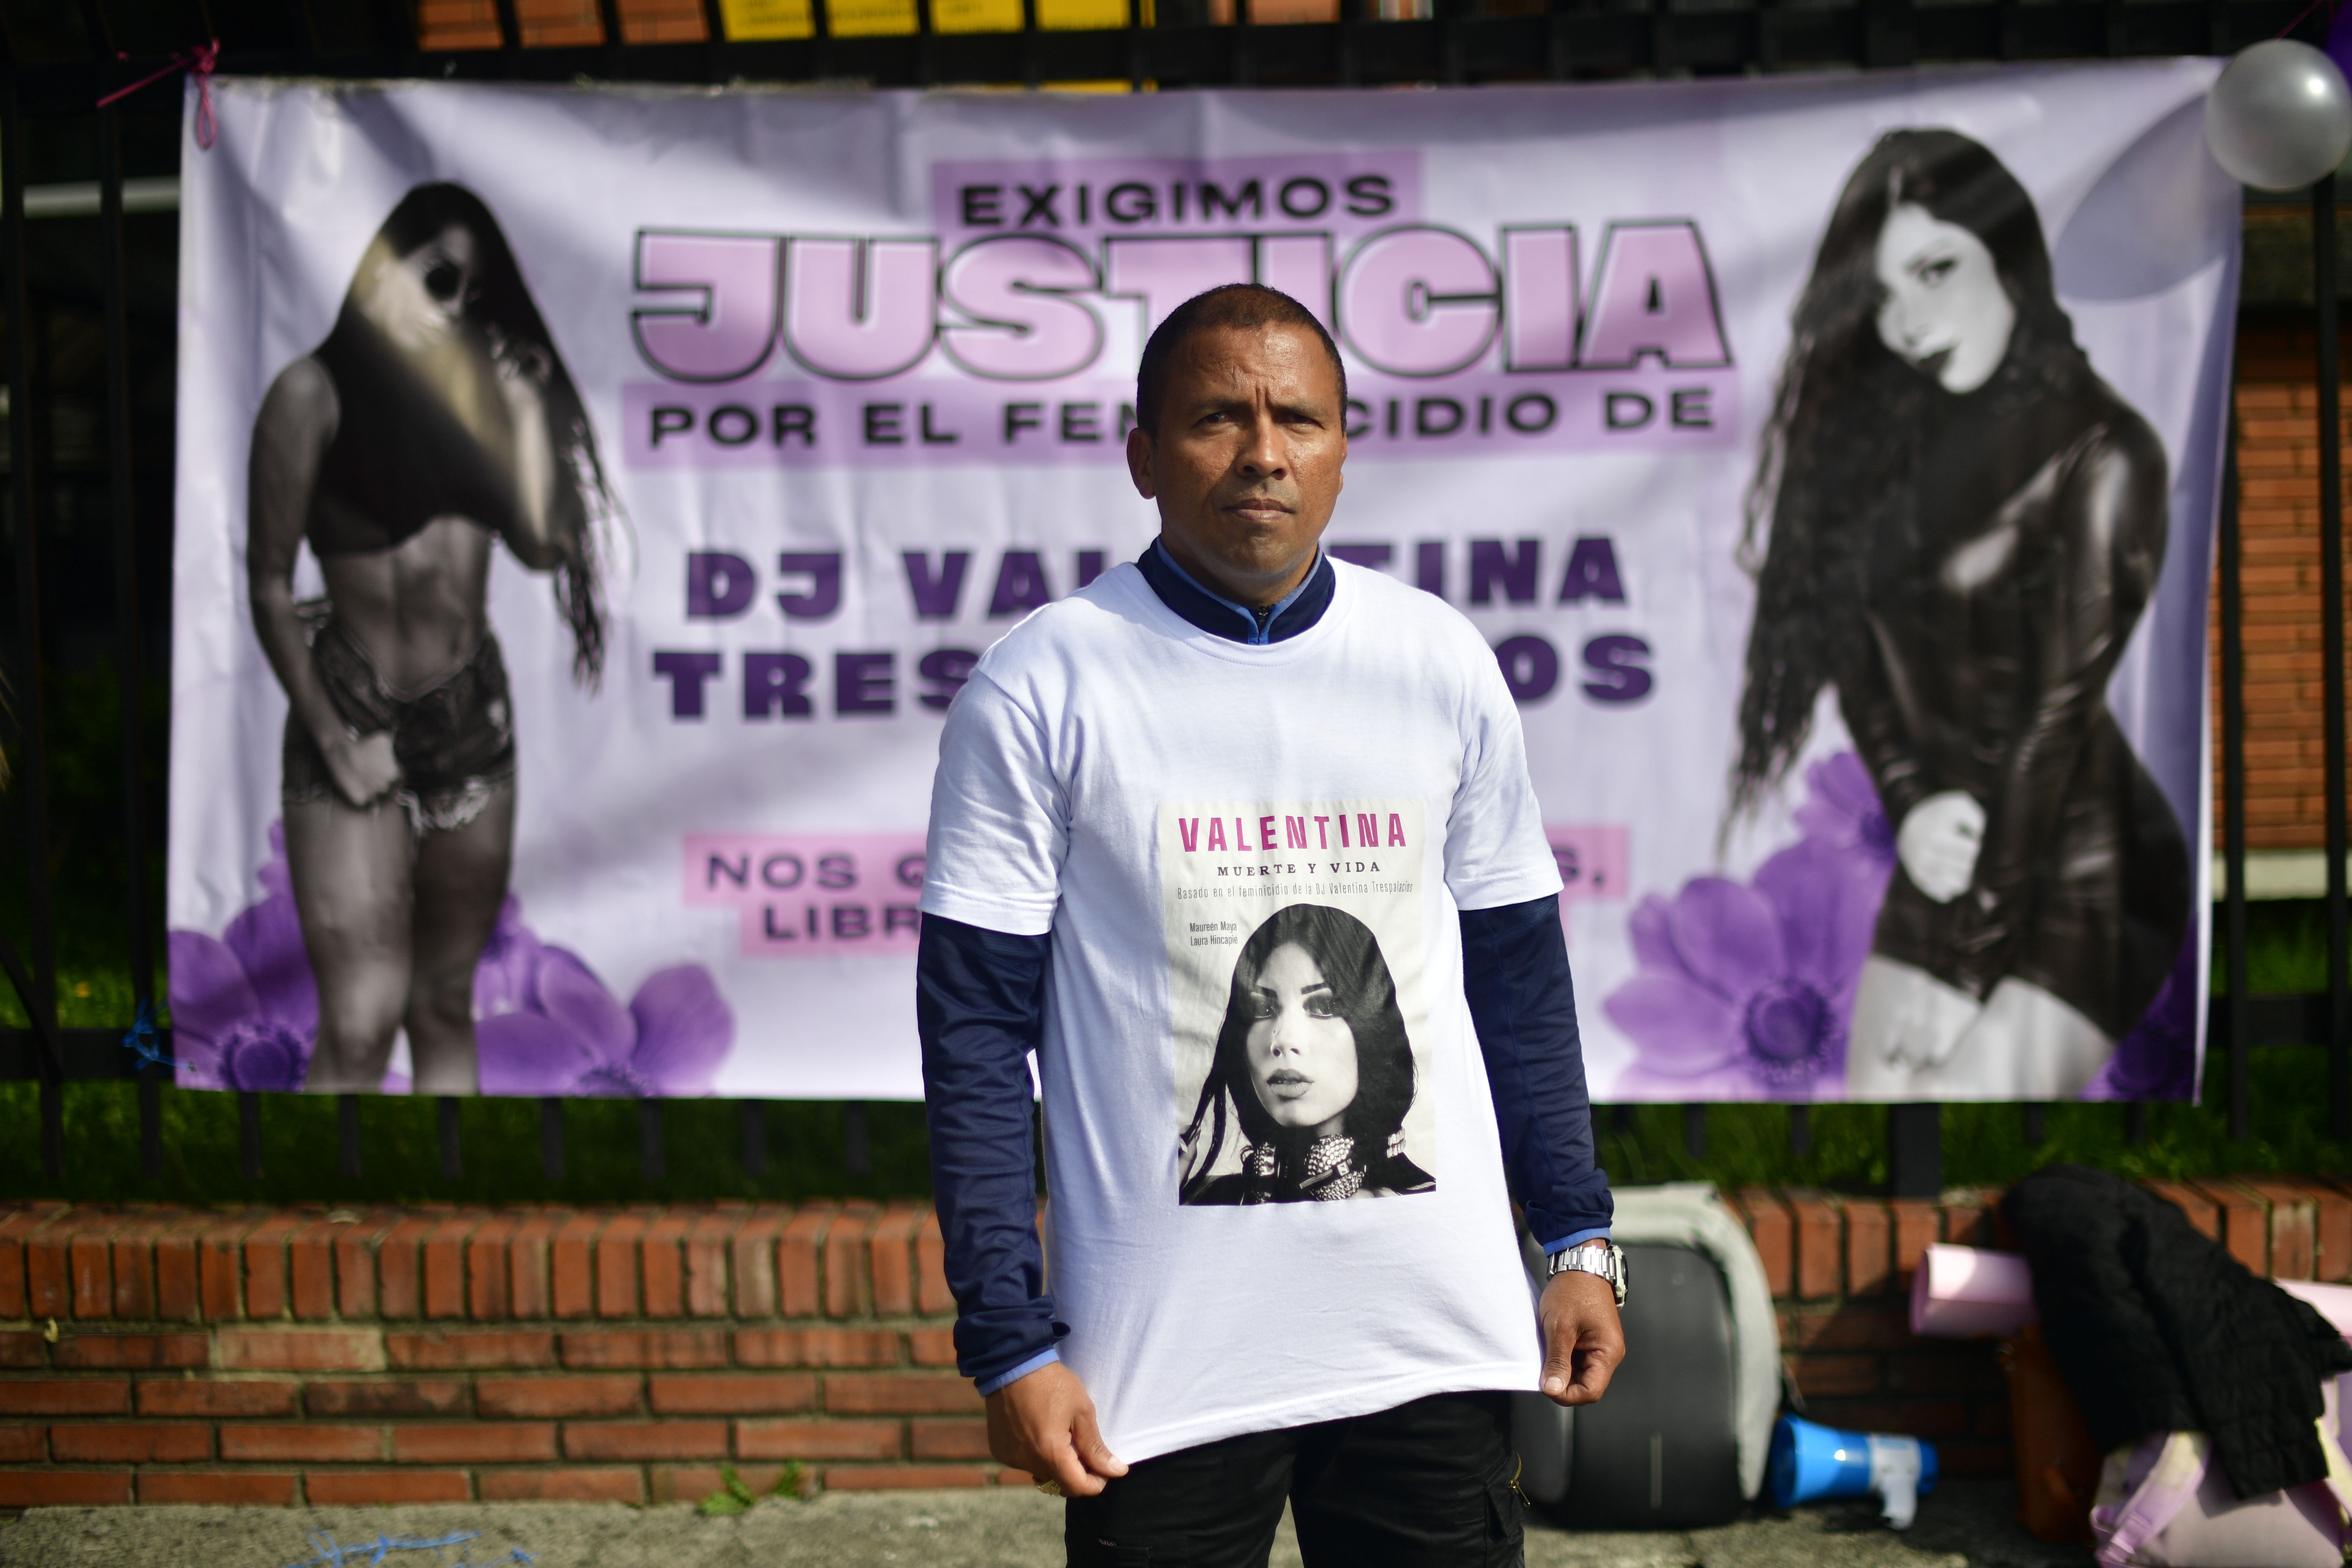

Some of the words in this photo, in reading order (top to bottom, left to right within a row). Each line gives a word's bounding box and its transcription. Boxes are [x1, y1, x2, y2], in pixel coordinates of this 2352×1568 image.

[962, 174, 1395, 226] EXIGIMOS
[629, 218, 1734, 384] JUSTICIA
[650, 404, 817, 447] POR
[863, 402, 958, 444] EL
[1605, 388, 1715, 430] DE
[686, 549, 844, 622] DJ
[1178, 813, 1406, 852] VALENTINA
[707, 854, 857, 890] NOS
[1217, 864, 1296, 876] MUERTE
[1307, 863, 1316, 874] Y
[1329, 862, 1380, 873] VIDA
[1178, 886, 1208, 899] Basado
[1213, 888, 1223, 898] en
[1228, 885, 1234, 897] el
[1239, 883, 1288, 897] feminicidio
[1293, 883, 1302, 894] de
[1305, 883, 1312, 894] la
[1316, 883, 1325, 895] DJ
[1329, 882, 1368, 894] Valentina
[1372, 881, 1413, 894] Trespalacios
[1190, 922, 1218, 932] Maureén
[1220, 921, 1237, 933] Maya
[1190, 936, 1208, 946] Laura
[1210, 934, 1238, 946] Hincapié
